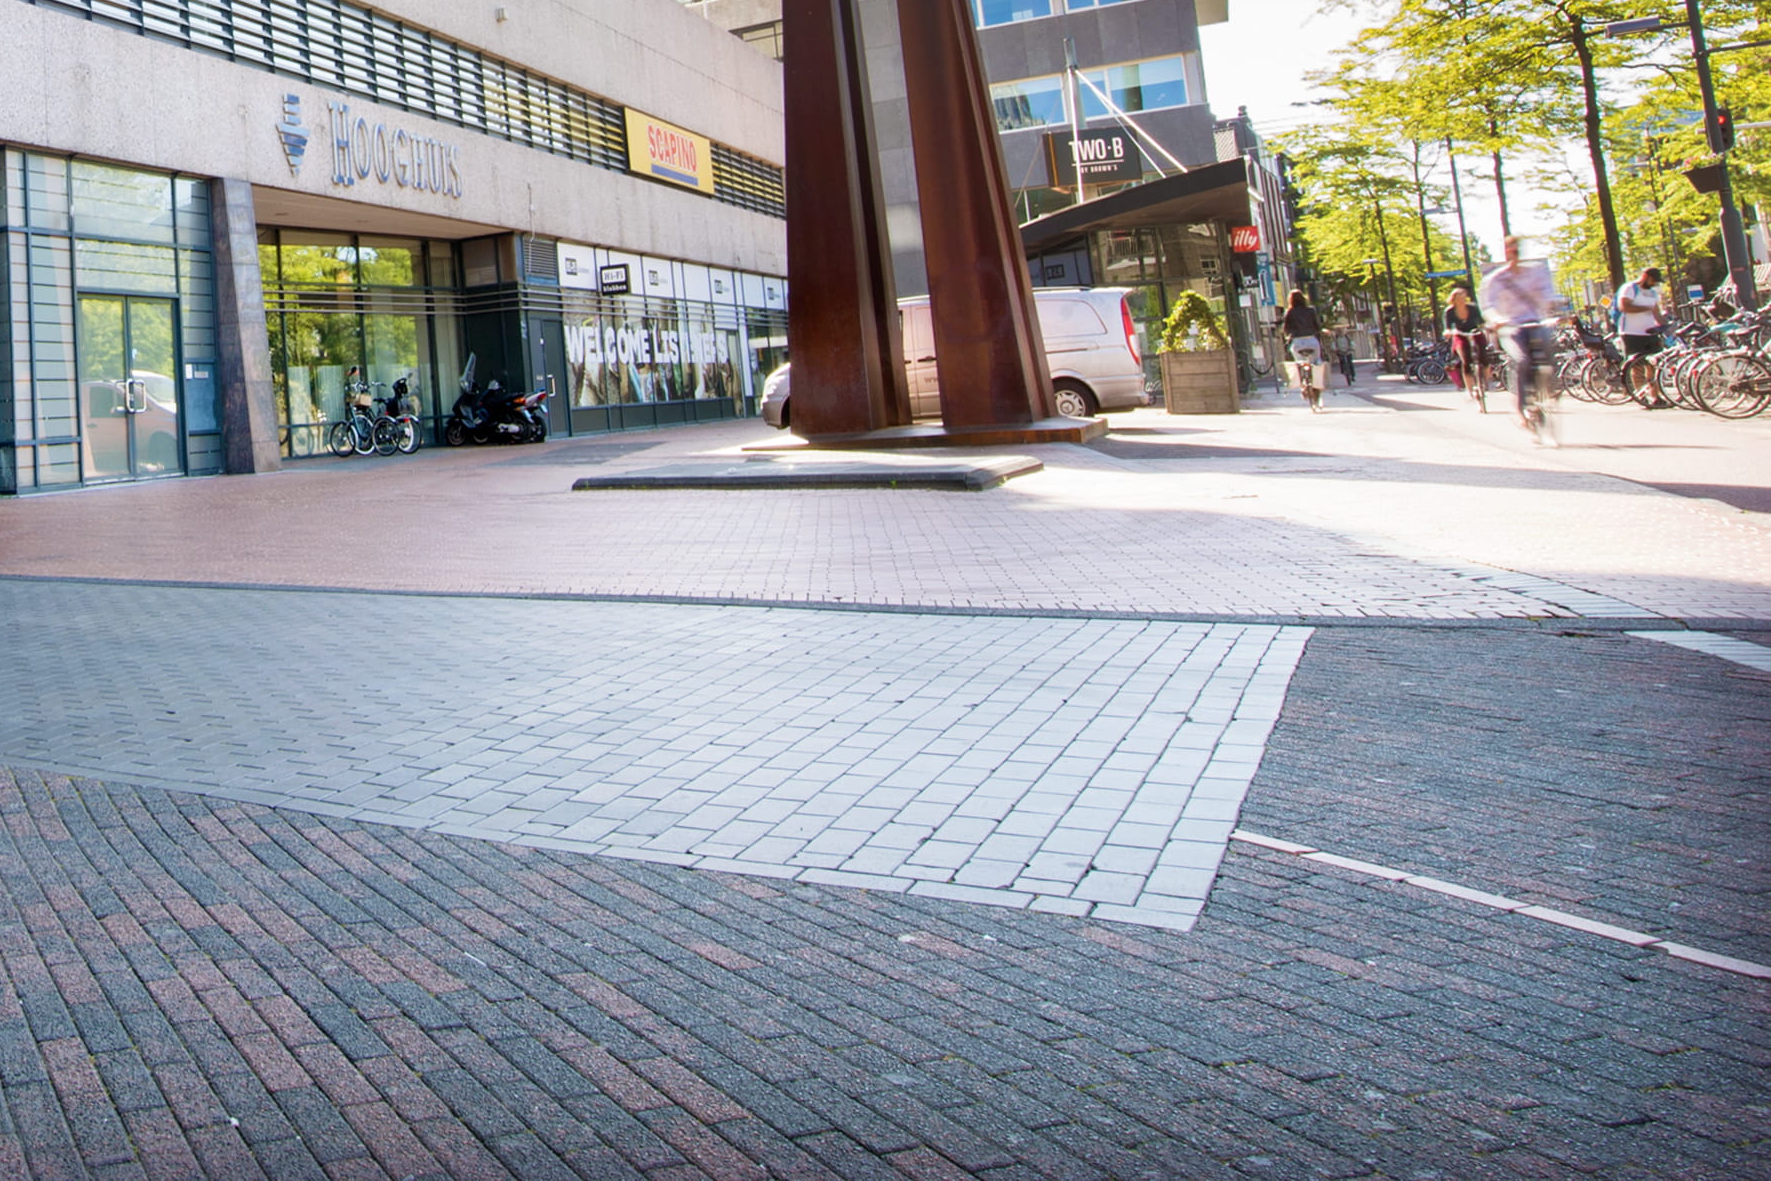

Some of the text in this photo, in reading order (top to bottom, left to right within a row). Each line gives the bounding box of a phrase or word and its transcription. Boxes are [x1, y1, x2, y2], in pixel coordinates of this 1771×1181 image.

[328, 100, 462, 199] HOOGHUIS
[647, 123, 698, 174] SCAPINO
[1234, 229, 1258, 250] illy
[563, 324, 651, 364] WELCOME
